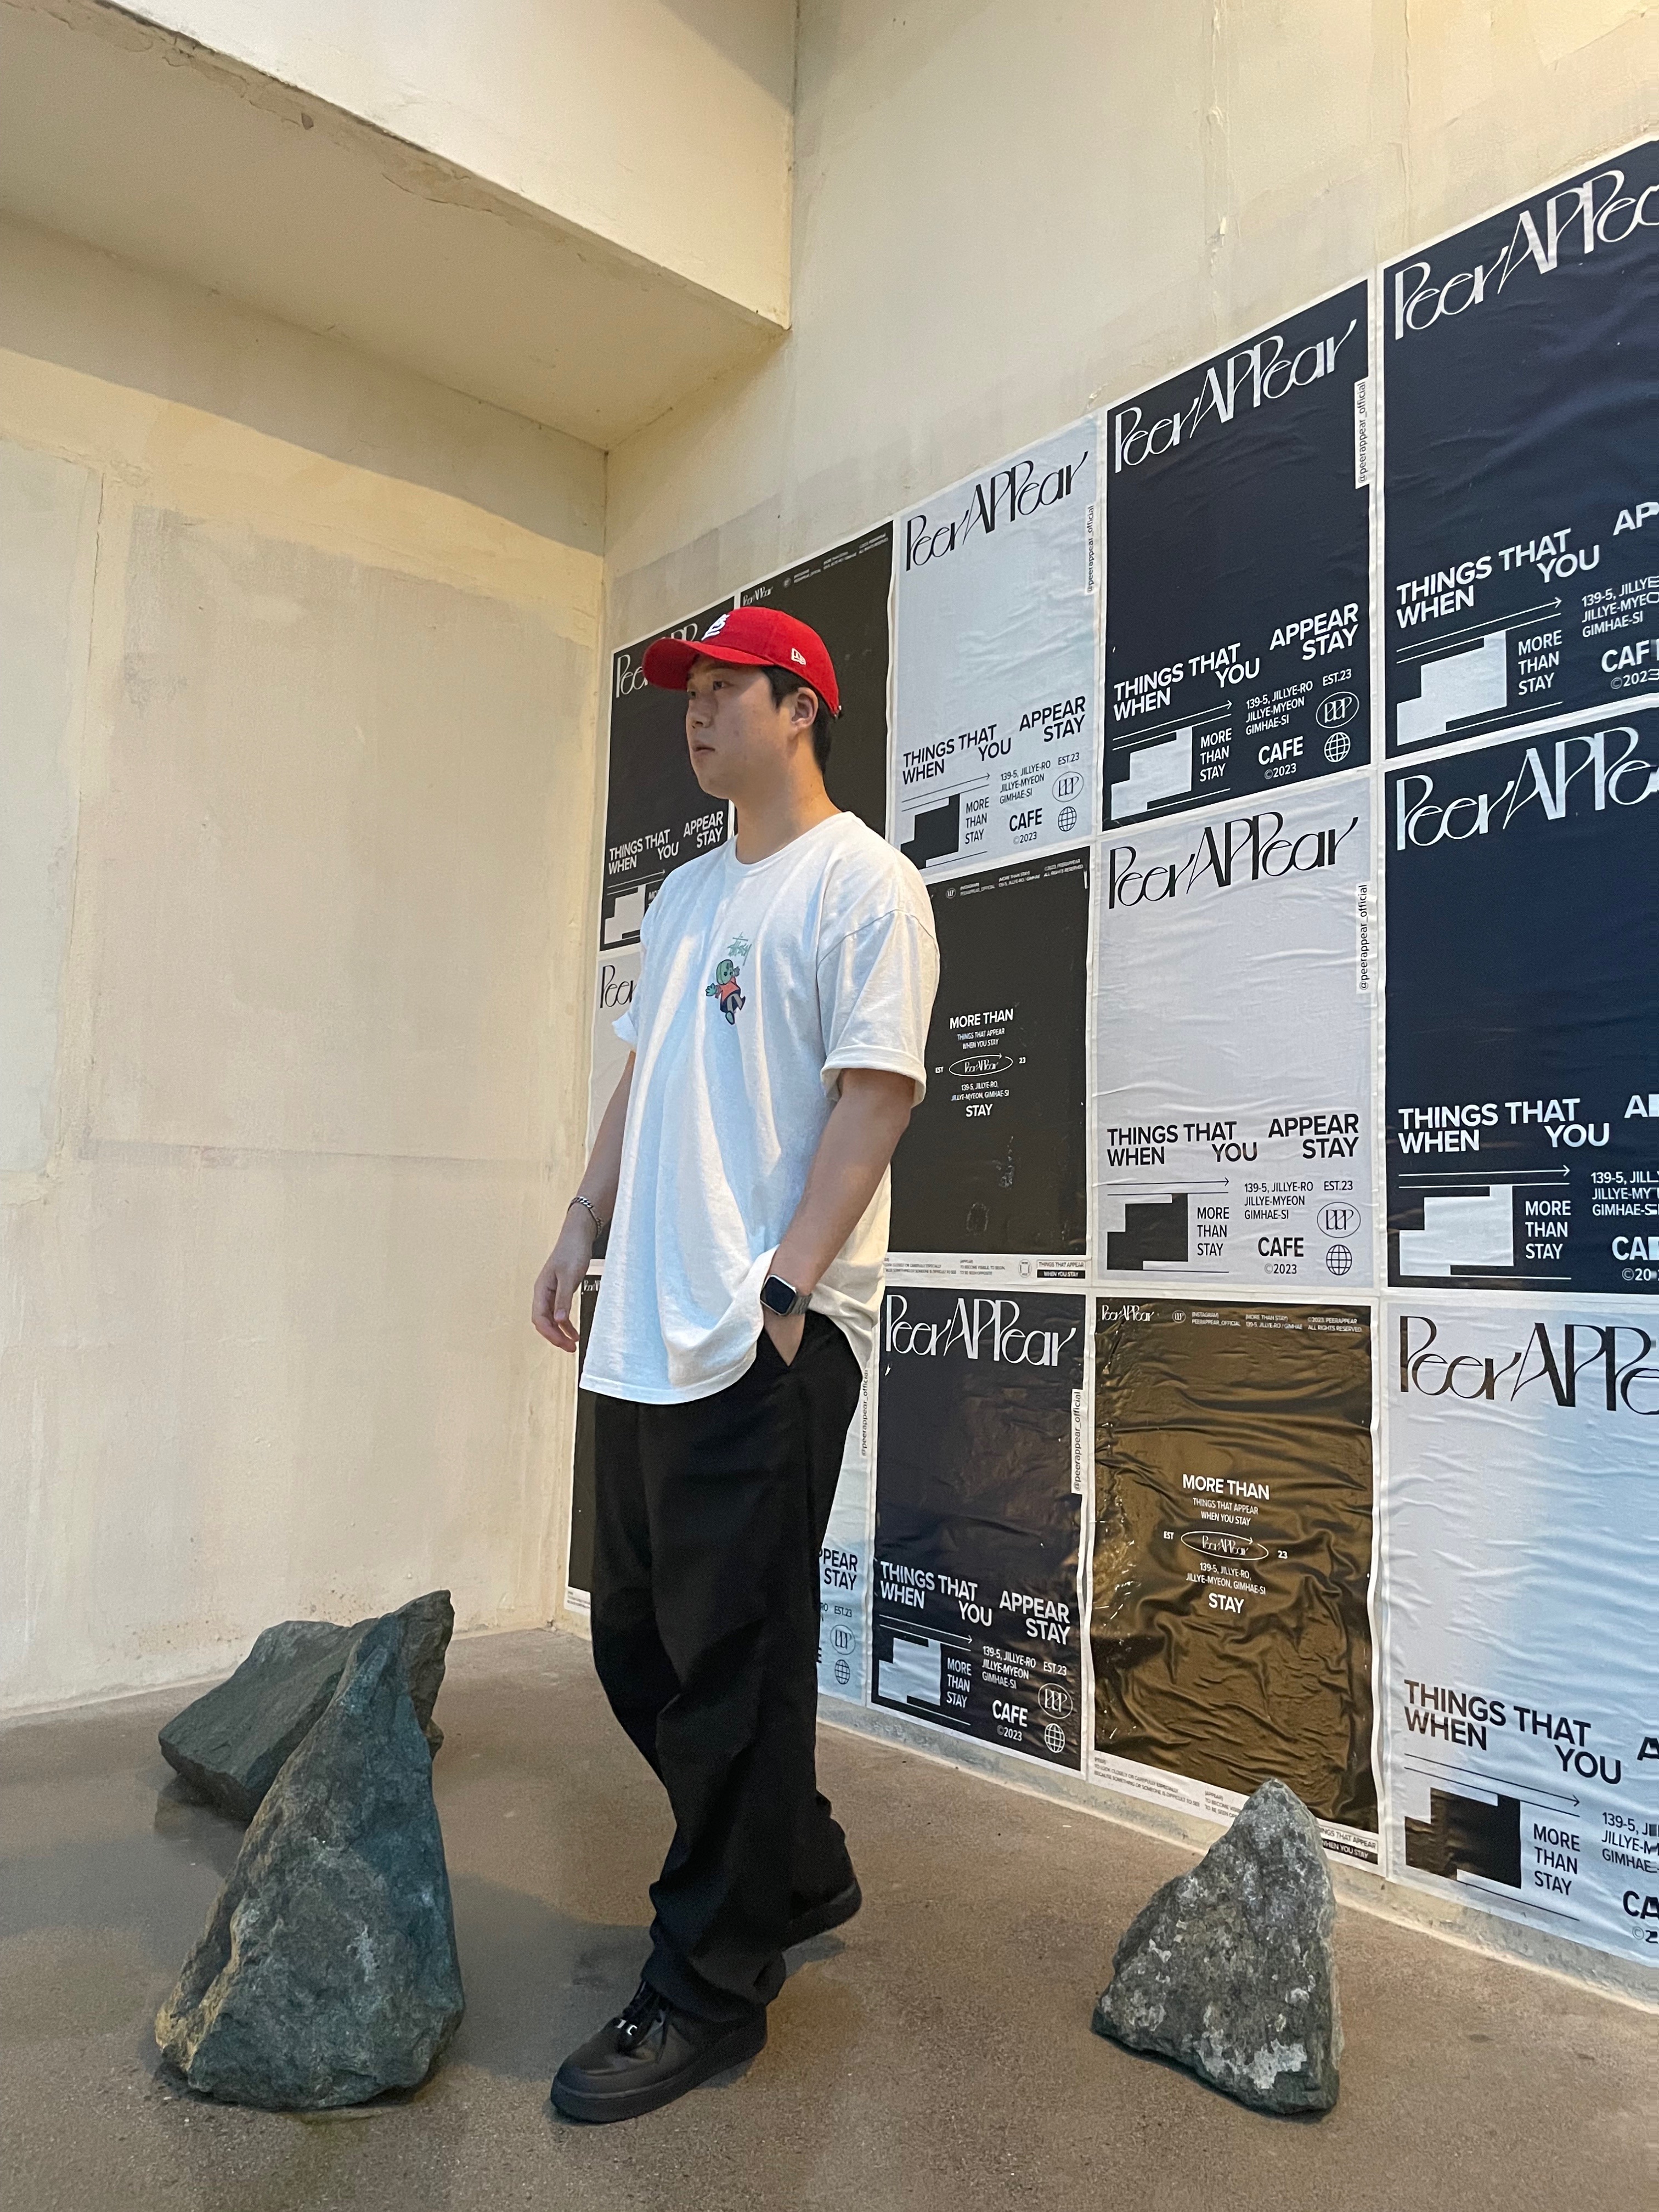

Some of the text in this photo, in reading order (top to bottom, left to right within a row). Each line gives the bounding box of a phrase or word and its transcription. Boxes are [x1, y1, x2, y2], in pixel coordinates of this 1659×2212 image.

[1358, 381, 1368, 483] @peerappear_official
[1396, 528, 1571, 605] THINGS THAT
[1396, 545, 1600, 629] WHEN YOU
[1582, 611, 1643, 637] GIMHAE-SI
[1113, 603, 1358, 701] THINGS THAT APPEAR
[1519, 630, 1562, 656] MORE
[1113, 624, 1359, 721] WHEN YOU STAY
[1519, 651, 1560, 675] THAN
[1323, 669, 1351, 686] EST.23
[1519, 673, 1554, 695] STAY
[1272, 681, 1313, 701] JILLYE-RO
[1245, 697, 1305, 723] JILLYE-MYEON
[904, 696, 1086, 768] THINGS THAT APPEAR
[1245, 714, 1289, 736] GIMHAE-SI
[1200, 728, 1232, 748] MORE
[903, 715, 1086, 785] WHEN YOU STAY
[1058, 753, 1079, 765] EST.23
[1200, 746, 1229, 765] THAN
[1258, 736, 1304, 765] CAFE
[1020, 761, 1051, 777] JILLYE-RO
[1199, 763, 1226, 782] STAY
[1000, 774, 1044, 793] JILLYE-MYEON
[966, 797, 989, 814] MORE
[1000, 788, 1032, 804] GIMHAE-SI
[966, 813, 987, 828] THAN
[1009, 808, 1042, 831] CAFE
[610, 811, 724, 861] THINGS THAT APPEAR
[965, 830, 984, 844] STAY
[608, 827, 724, 874] WHEN YOU STAY
[1359, 884, 1369, 990] @peerappear_official
[950, 1008, 1013, 1029] MORE THAN
[987, 1028, 1005, 1036] APPEAR
[966, 1104, 993, 1117] STAY
[1398, 1098, 1581, 1130] THINGS THAT
[1107, 1113, 1359, 1146] THINGS THAT APPEAR
[1398, 1123, 1610, 1154] WHEN YOU
[1107, 1137, 1359, 1166] WHEN YOU STAY
[1271, 1182, 1313, 1192] JILLYE-RO
[1324, 1181, 1353, 1191] EST.23
[1244, 1195, 1305, 1206] JILLYE-MYEON
[1525, 1200, 1571, 1215] MORE
[1197, 1207, 1229, 1220] MORE
[1244, 1210, 1289, 1220] GIMHAE-SI
[1197, 1225, 1227, 1238] THAN
[1525, 1222, 1568, 1237] THAN
[1197, 1243, 1223, 1256] STAY
[1258, 1237, 1304, 1258] CAFE
[1525, 1243, 1563, 1259] STAY
[1074, 1392, 1082, 1491] @peerappear_official
[1183, 1474, 1269, 1500] MORE THAN
[1193, 1498, 1259, 1515] THINGS THAT APPEAR
[1201, 1511, 1251, 1526] WHEN YOU STAY
[1164, 1531, 1174, 1539] EST
[1278, 1550, 1288, 1559] 23
[824, 1568, 857, 1590] STAY
[1233, 1581, 1266, 1595] GIMHAE-SI
[881, 1561, 1070, 1623] THINGS THAT APPEAR
[880, 1581, 1070, 1645] WHEN YOU STAY
[1209, 1593, 1244, 1613] STAY
[947, 1658, 972, 1676] MORE
[982, 1658, 1029, 1679] JILLYE-MYEON
[1003, 1651, 1036, 1668] JILLYE-RO
[1043, 1662, 1066, 1676] EST.23
[947, 1674, 970, 1692] THAN
[982, 1672, 1016, 1689] GIMHAE-SI
[947, 1691, 967, 1708] STAY
[992, 1700, 1028, 1727] CAFE
[1404, 1679, 1592, 1747] THINGS THAT
[1404, 1706, 1487, 1751] WHEN
[1554, 1744, 1621, 1785] YOU
[1353, 1837, 1376, 1849] APPEAR
[1533, 1824, 1580, 1852] MORE
[1340, 1844, 1353, 1854] YOU
[1354, 1849, 1368, 1859] STAY
[1533, 1847, 1578, 1874] THAN
[1534, 1870, 1572, 1895] STAY
